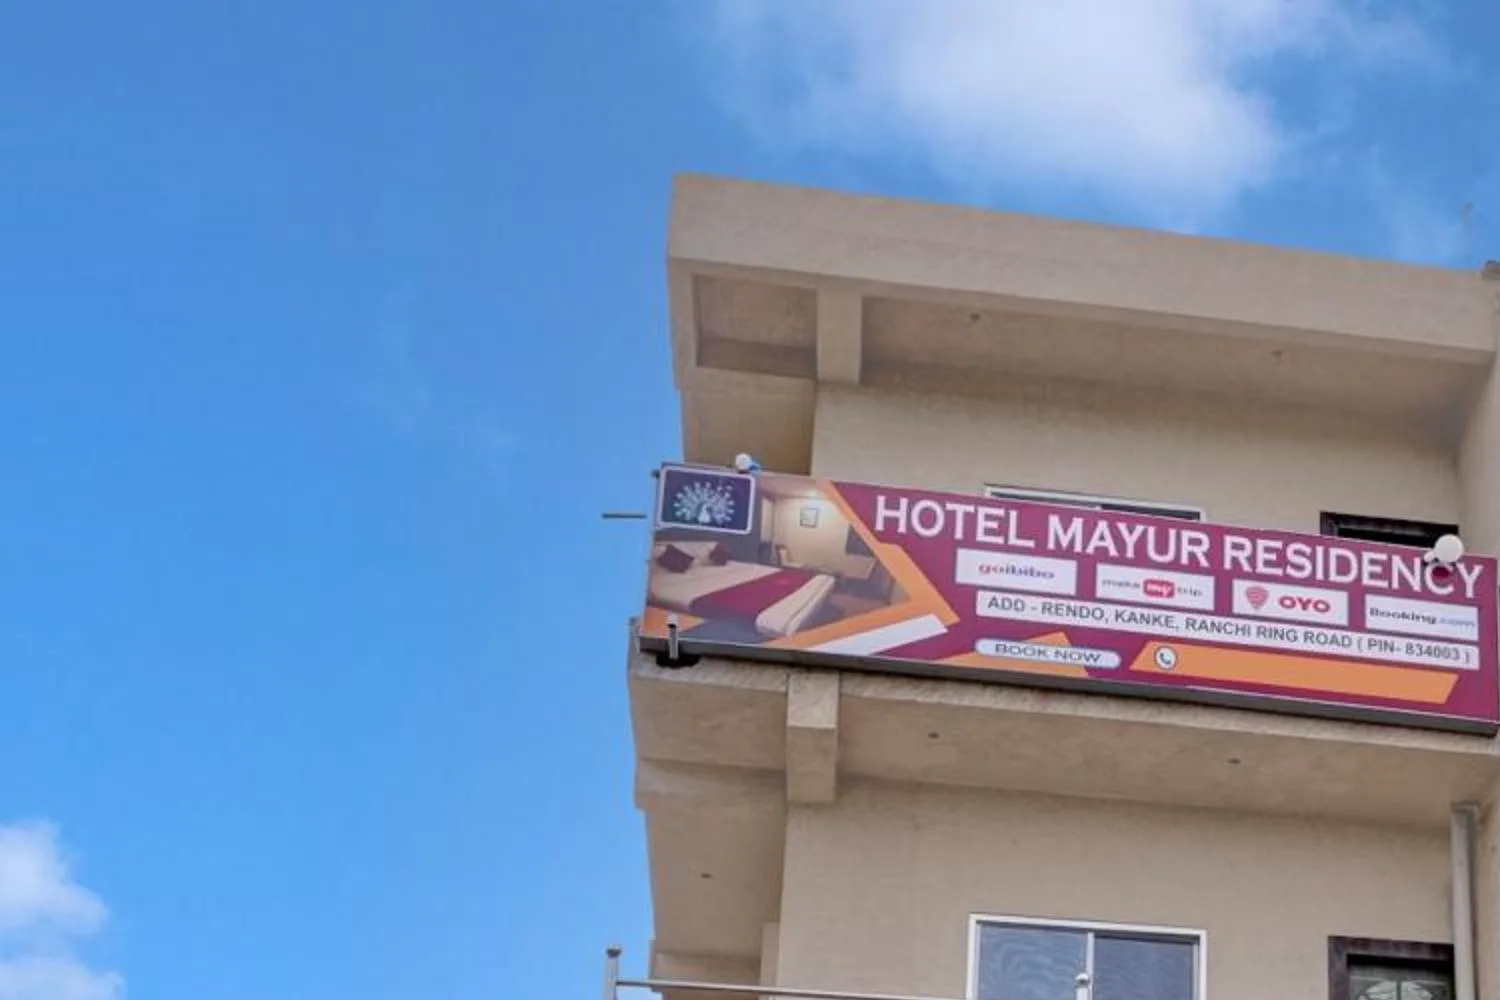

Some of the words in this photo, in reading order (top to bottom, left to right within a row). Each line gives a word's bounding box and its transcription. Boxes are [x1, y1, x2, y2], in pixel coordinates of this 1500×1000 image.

[874, 494, 1034, 549] HOTEL
[1047, 516, 1209, 566] MAYUR
[1223, 535, 1484, 600] RESIDENCY
[978, 562, 1055, 580] goibibo
[1278, 595, 1331, 614] OYO
[988, 596, 1025, 613] ADD
[1041, 602, 1109, 624] RENDO,
[1115, 610, 1180, 631] KANKE,
[1185, 618, 1251, 638] RANCHI
[1256, 626, 1299, 643] RING
[1303, 630, 1351, 648] ROAD
[995, 644, 1048, 659] BOOK
[1054, 649, 1102, 665] NOW
